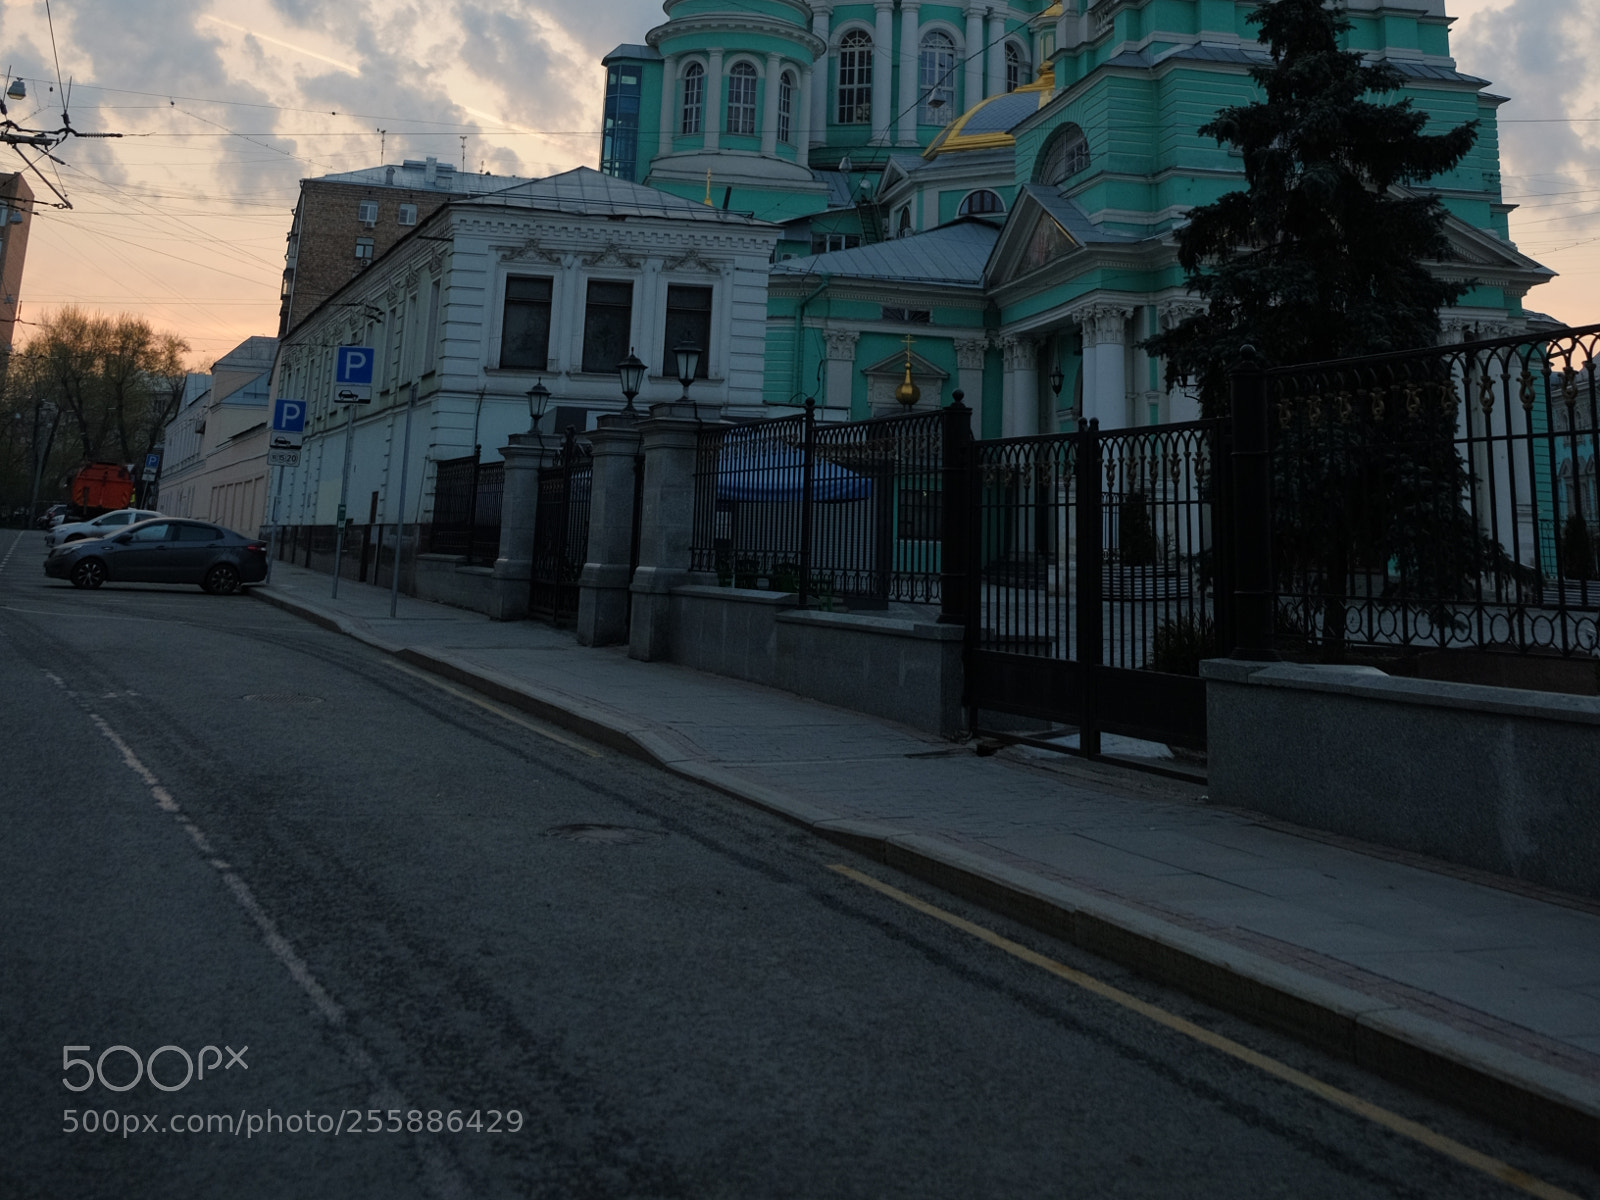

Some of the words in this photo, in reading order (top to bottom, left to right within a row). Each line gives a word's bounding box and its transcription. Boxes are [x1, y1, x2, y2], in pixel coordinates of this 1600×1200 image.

[344, 351, 367, 380] P
[281, 402, 301, 429] P
[286, 454, 297, 462] 20
